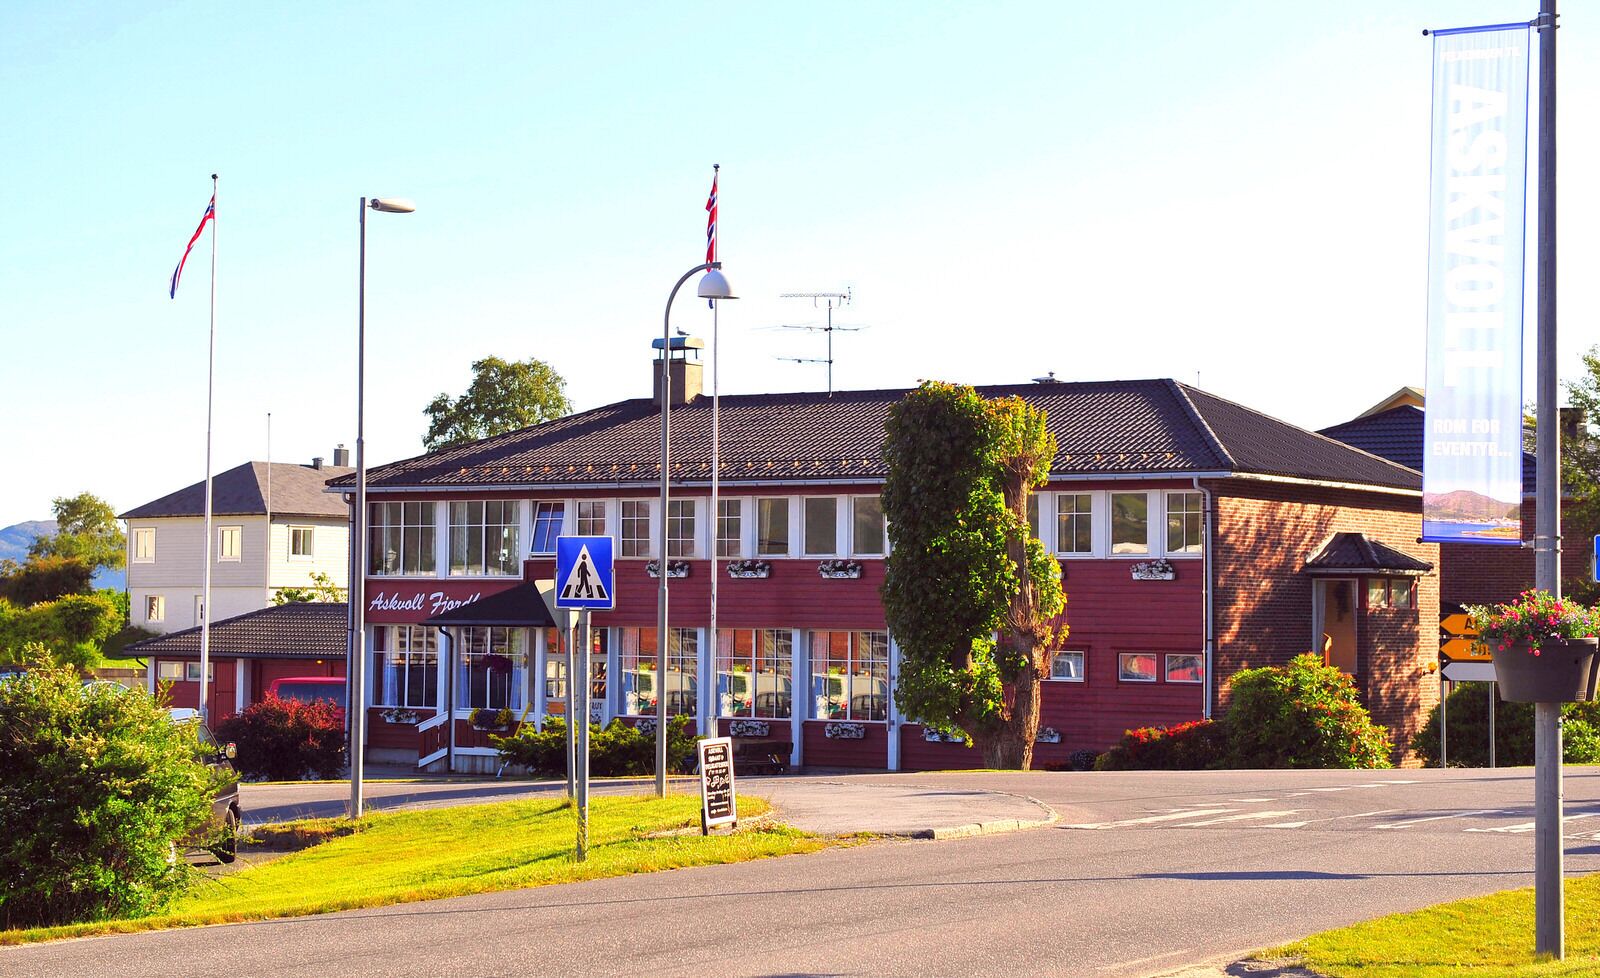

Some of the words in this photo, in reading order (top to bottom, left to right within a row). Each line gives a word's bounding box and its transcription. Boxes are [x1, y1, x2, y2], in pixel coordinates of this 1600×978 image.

[1444, 82, 1508, 388] ASKVOLL
[1433, 418, 1467, 434] ROM
[1471, 418, 1501, 434] FOR
[368, 591, 426, 611] Askvoll
